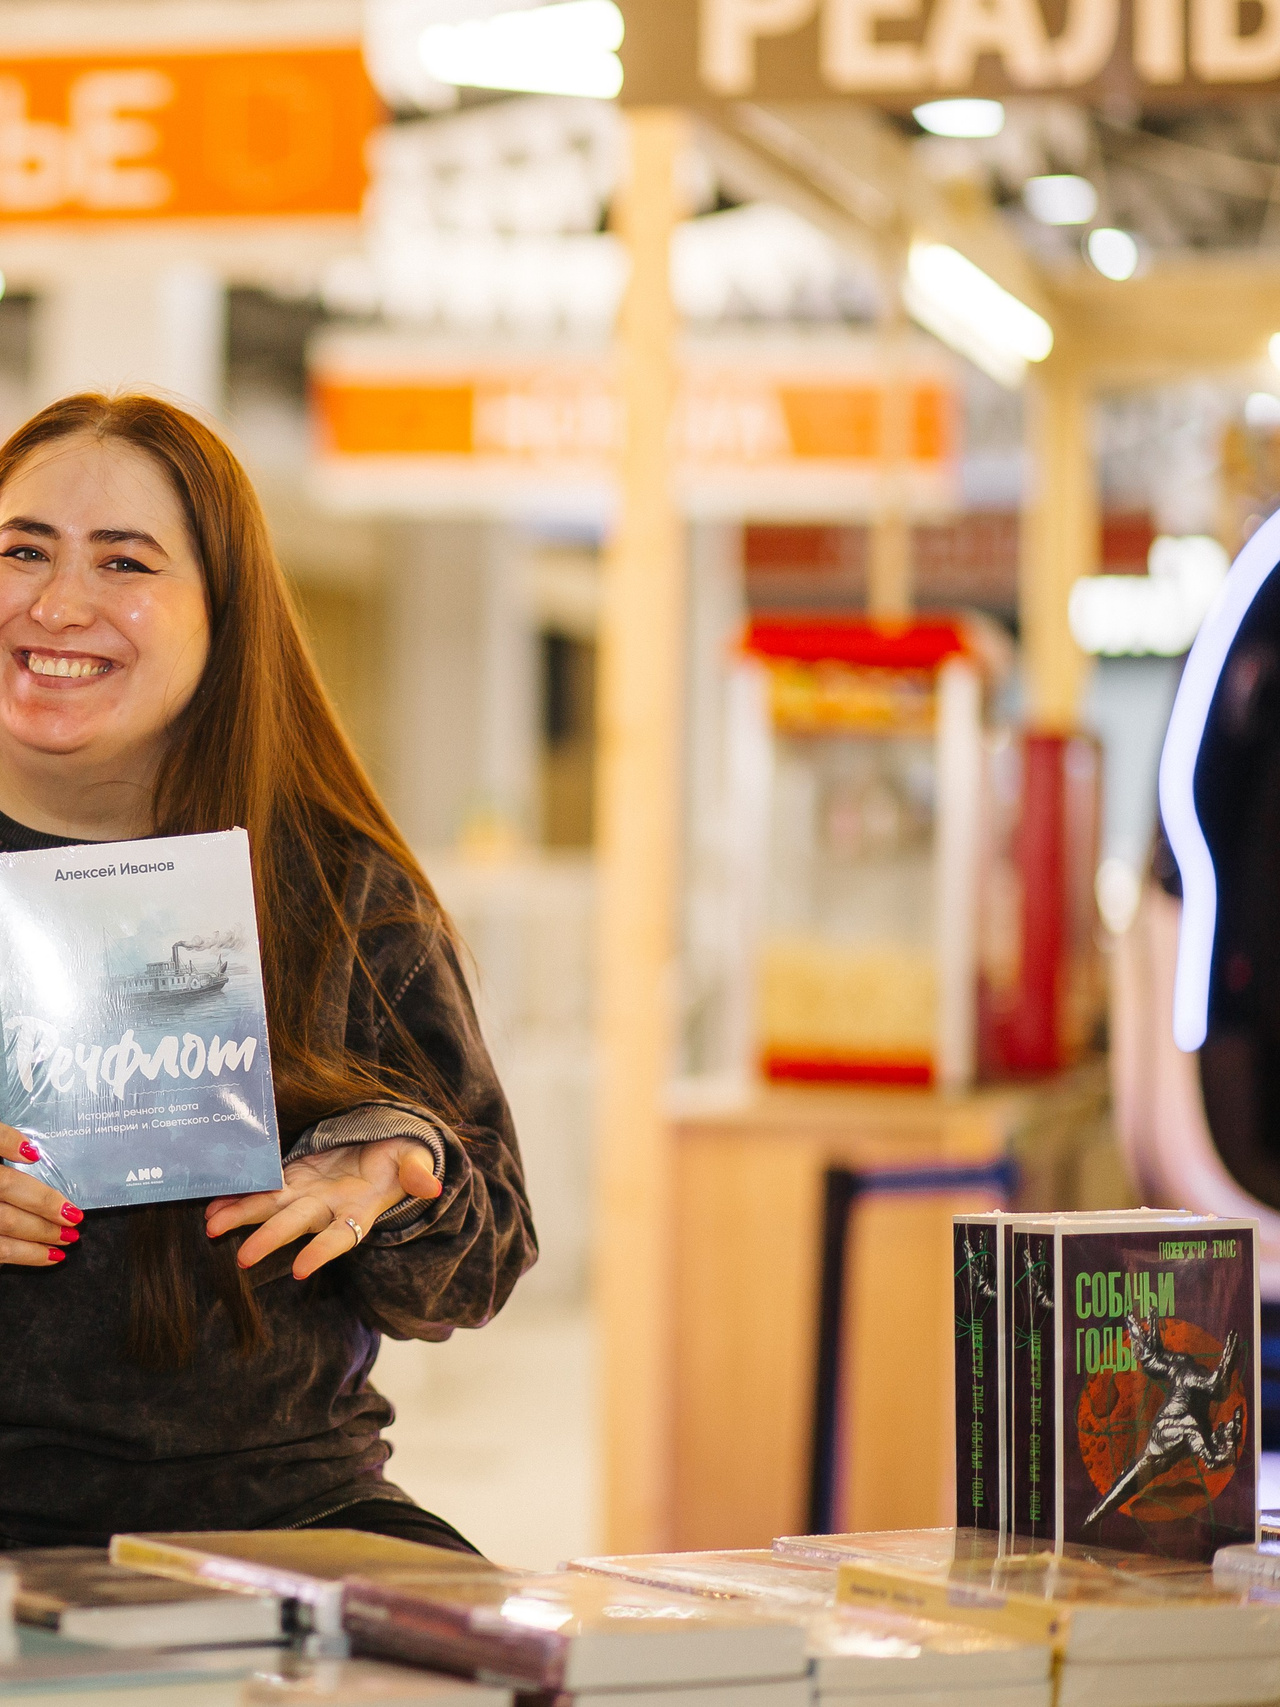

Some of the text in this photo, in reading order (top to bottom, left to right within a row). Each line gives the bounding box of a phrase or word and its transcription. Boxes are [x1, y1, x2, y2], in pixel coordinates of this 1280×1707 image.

[54, 861, 175, 881] Алексей Иванов
[4, 1015, 258, 1100] Речфлот
[77, 1102, 199, 1122] История речного флота
[95, 1122, 139, 1136] империи
[142, 1122, 149, 1130] и
[151, 1115, 210, 1129] Советского
[1075, 1271, 1176, 1319] СОБАЧЬИ
[1076, 1326, 1138, 1375] ГОДЫ
